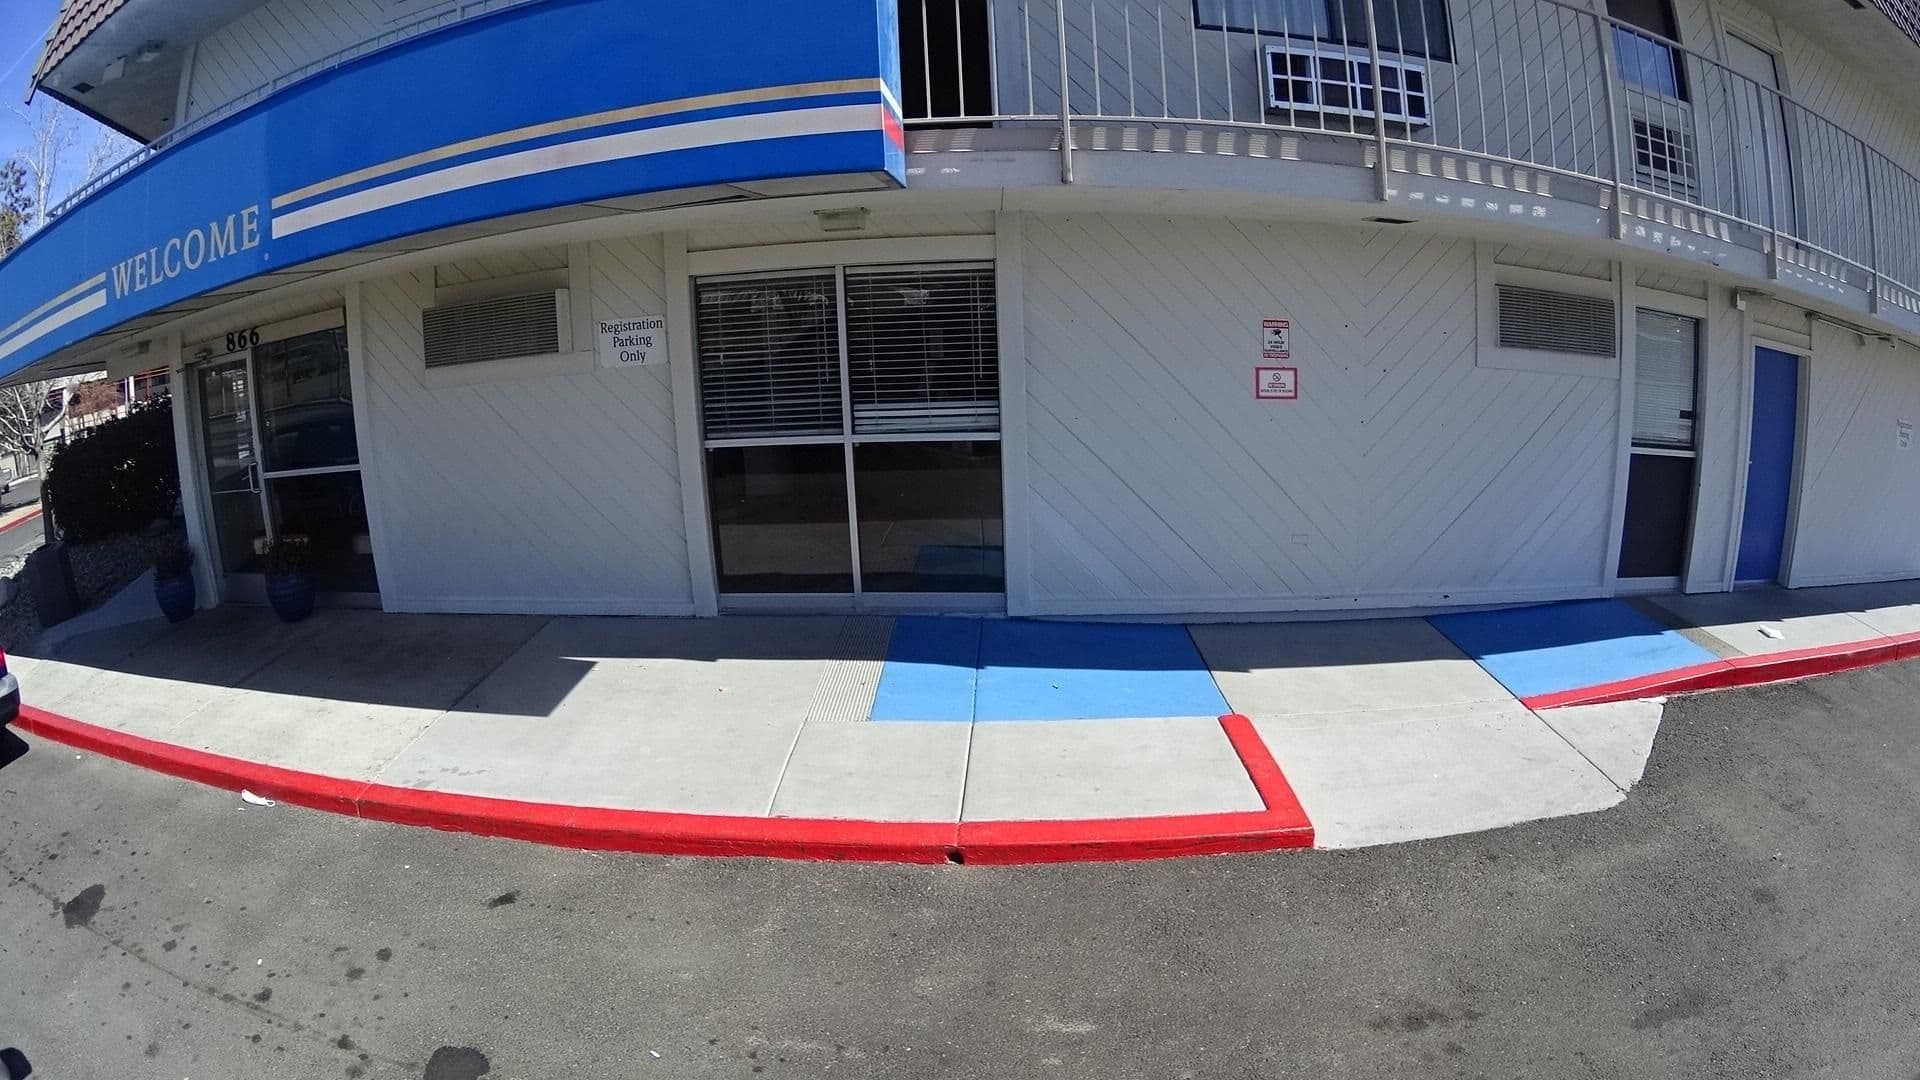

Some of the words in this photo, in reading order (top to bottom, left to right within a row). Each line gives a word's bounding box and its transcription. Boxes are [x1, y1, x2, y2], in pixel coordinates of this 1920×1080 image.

[112, 205, 260, 299] WELCOME
[600, 318, 663, 335] Registration
[226, 328, 260, 352] 866
[613, 335, 653, 348] Parking
[620, 350, 646, 364] Only
